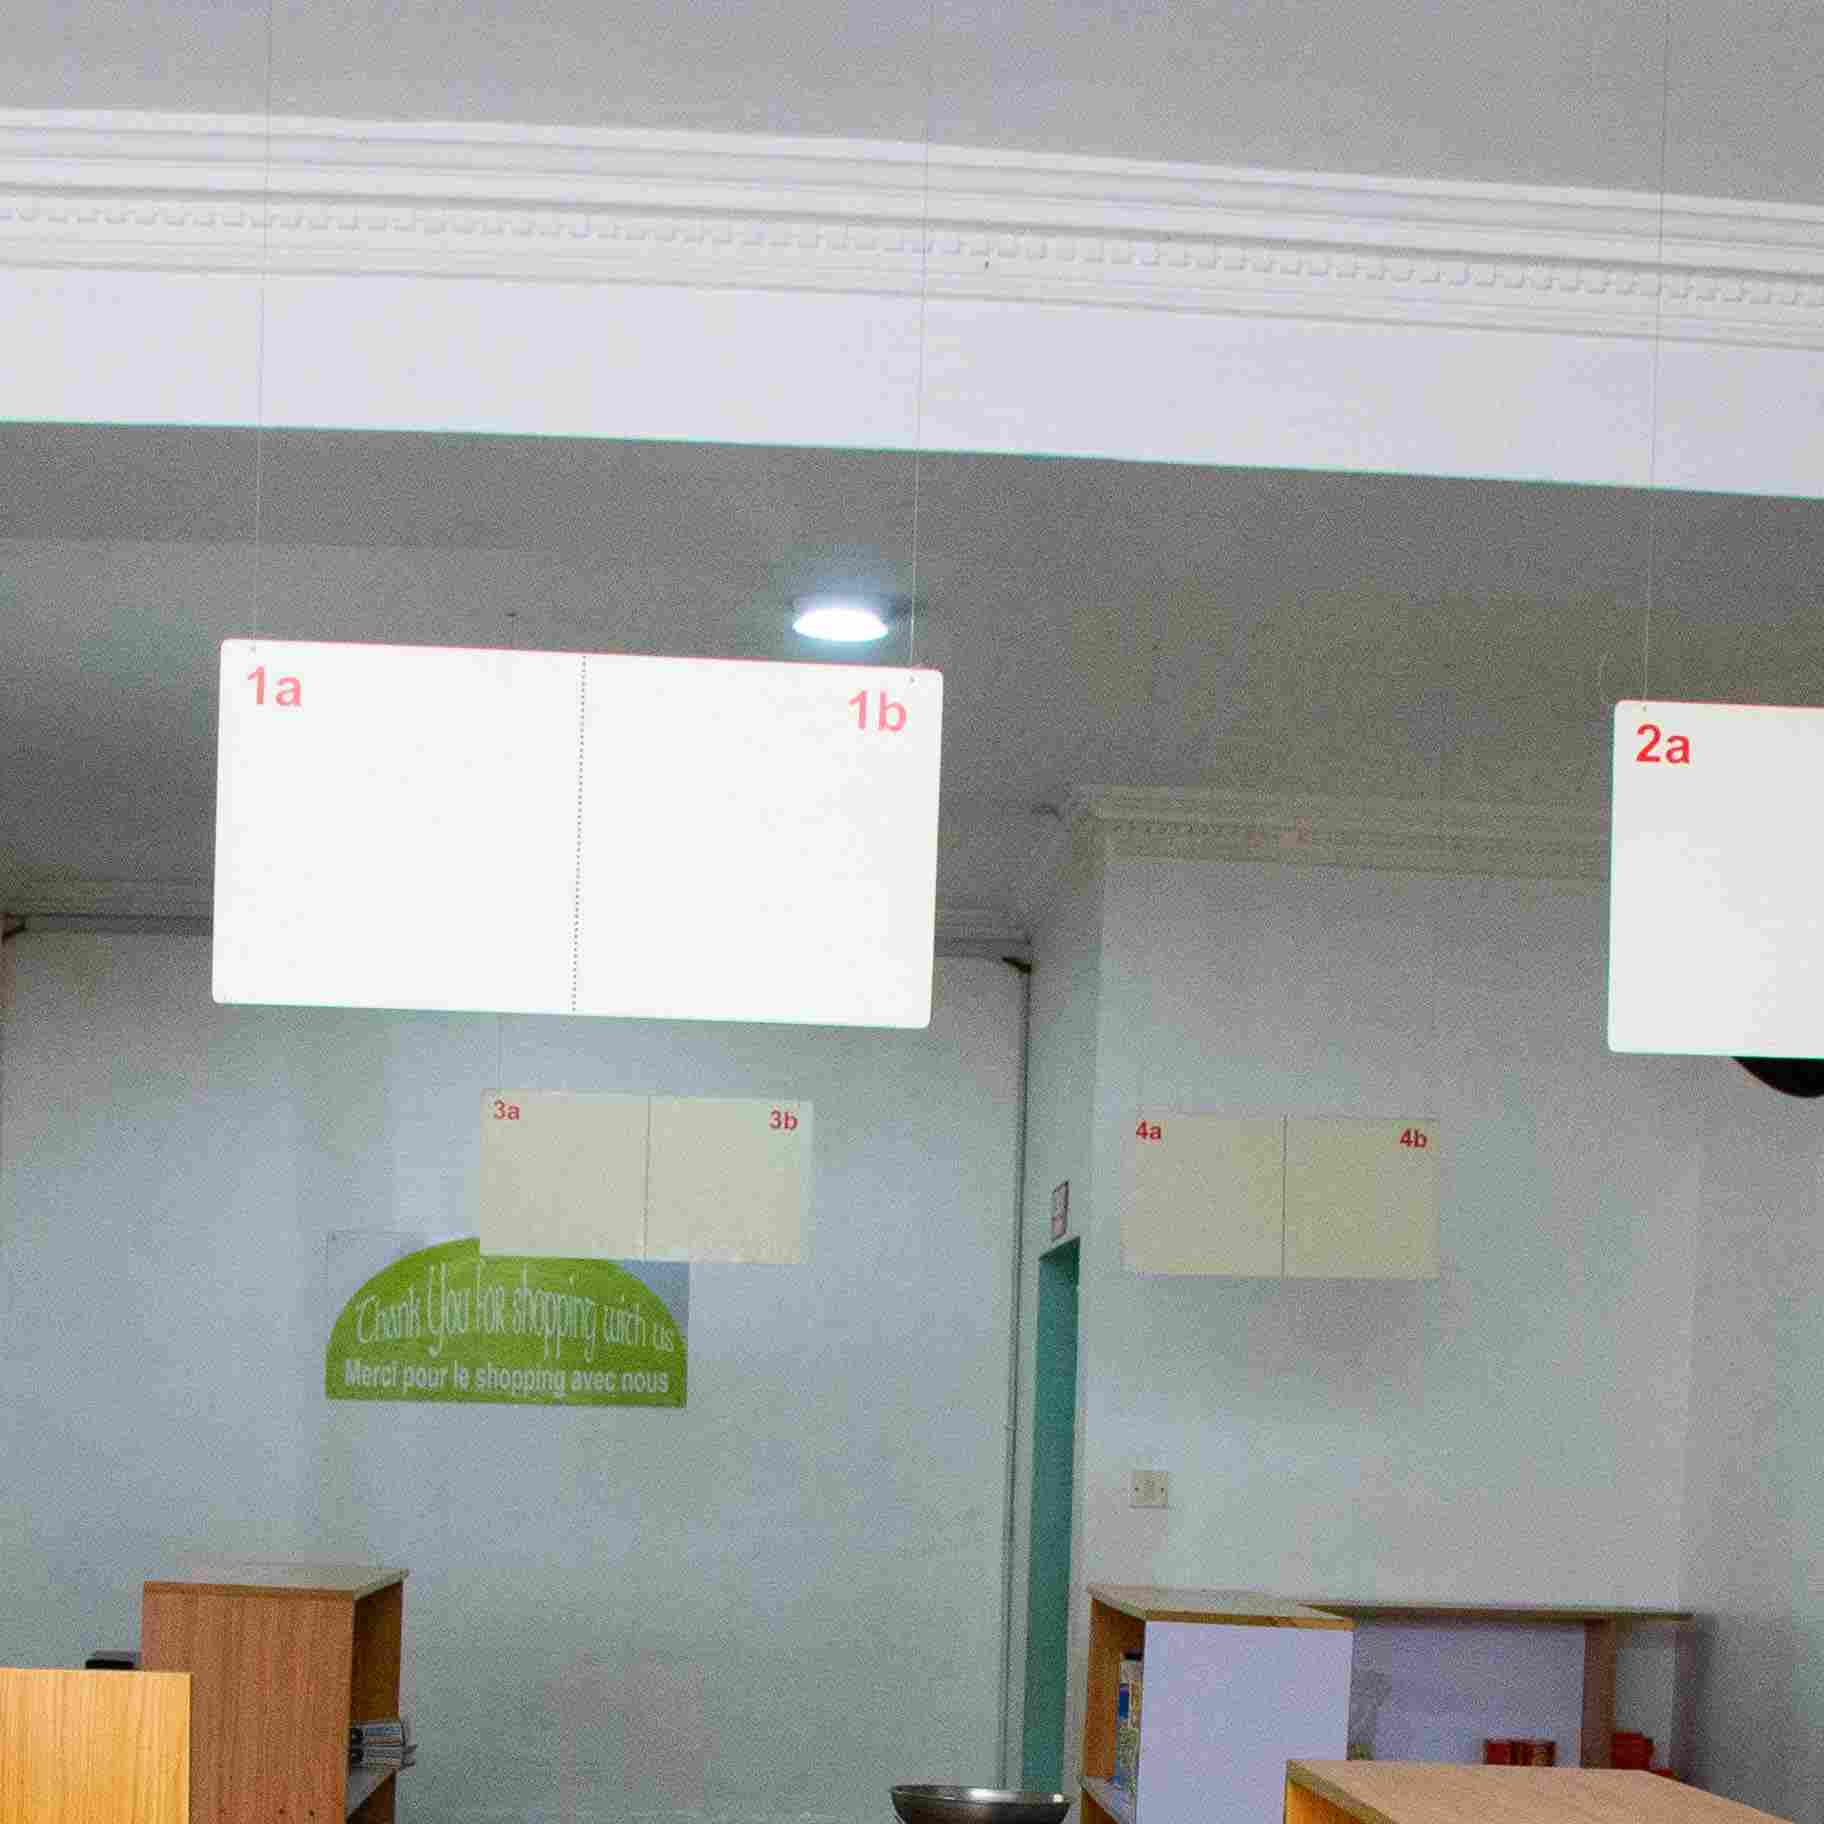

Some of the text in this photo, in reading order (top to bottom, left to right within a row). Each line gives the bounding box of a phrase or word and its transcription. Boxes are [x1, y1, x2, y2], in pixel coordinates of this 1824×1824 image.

[245, 665, 303, 707] 1a
[847, 689, 908, 733] 1b
[1635, 724, 1691, 764] 2a
[492, 1100, 521, 1121] 3a
[768, 1110, 798, 1131] 3b
[1135, 1121, 1162, 1140] 4a
[1399, 1128, 1429, 1149] 4b
[345, 1360, 397, 1388] Merci
[401, 1366, 448, 1396] pour
[476, 1361, 566, 1398] shopping
[571, 1369, 616, 1392] avec
[621, 1372, 669, 1393] nous
